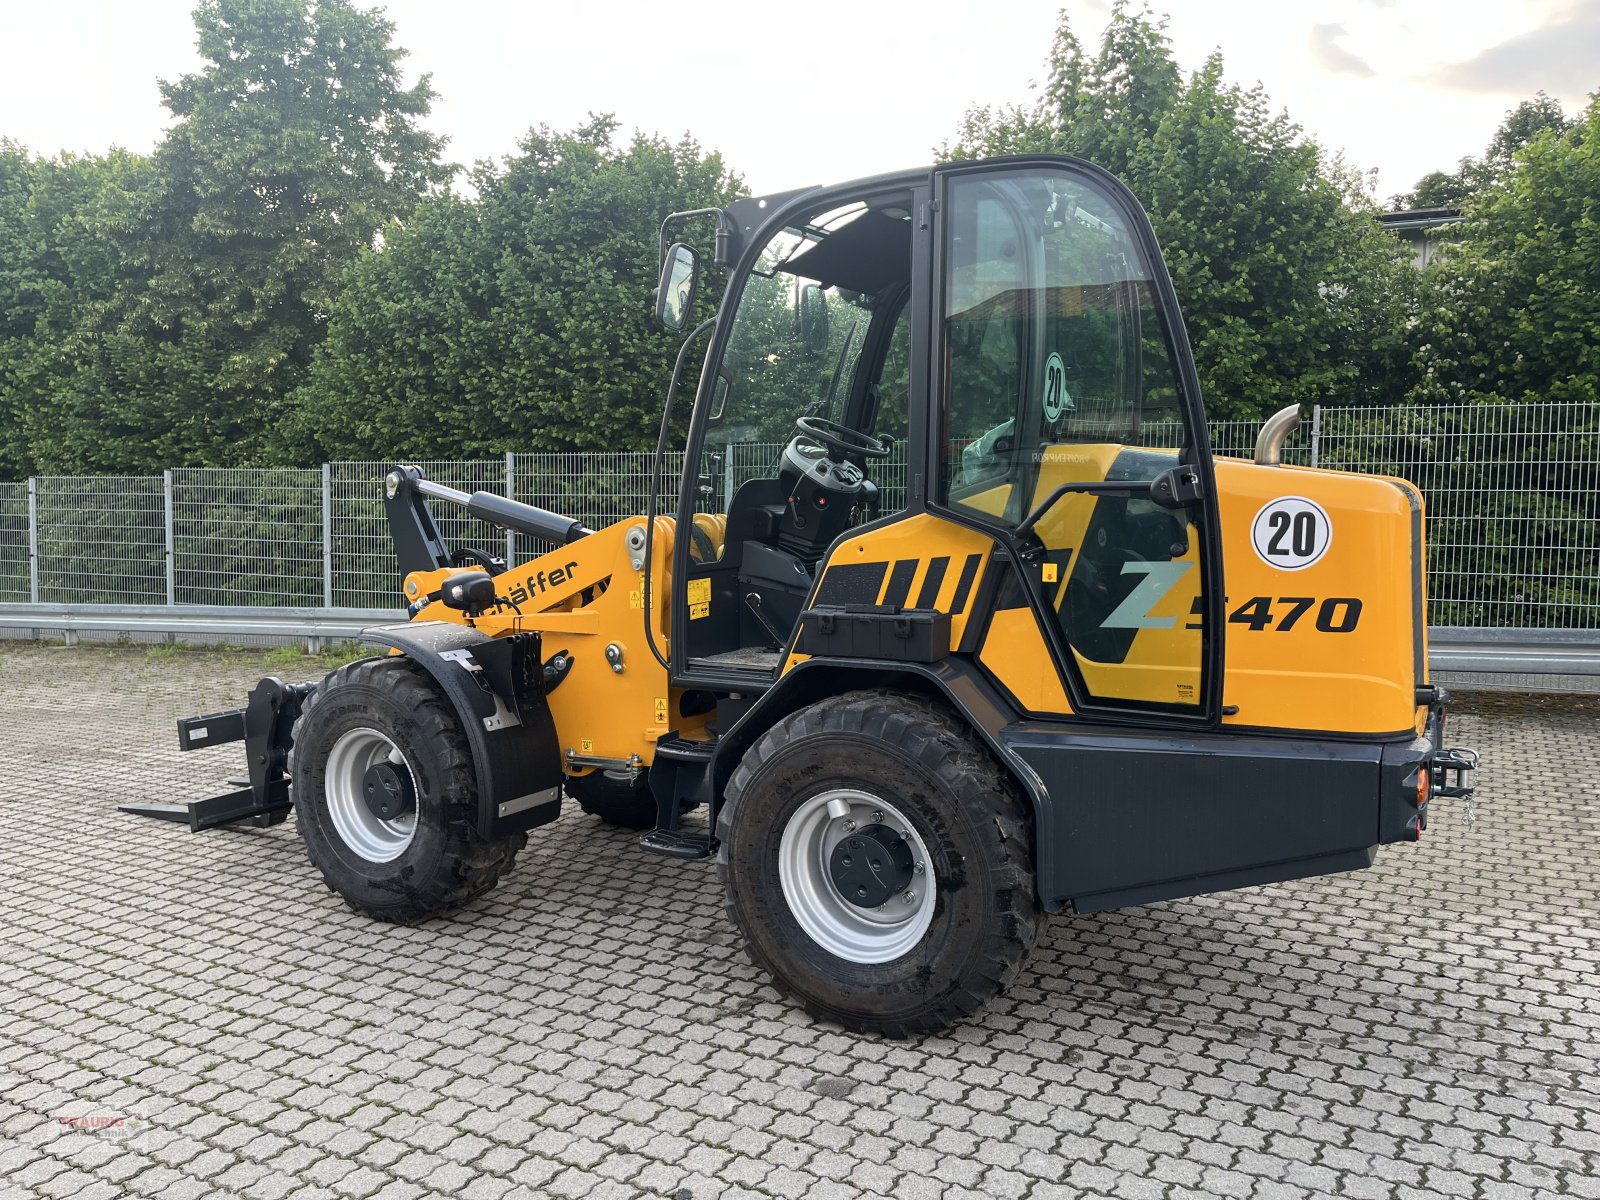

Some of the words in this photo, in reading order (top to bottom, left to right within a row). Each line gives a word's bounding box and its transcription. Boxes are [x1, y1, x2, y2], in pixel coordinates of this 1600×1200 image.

[1047, 365, 1062, 409] 20
[1267, 510, 1316, 557] 20
[1100, 561, 1194, 629] Z
